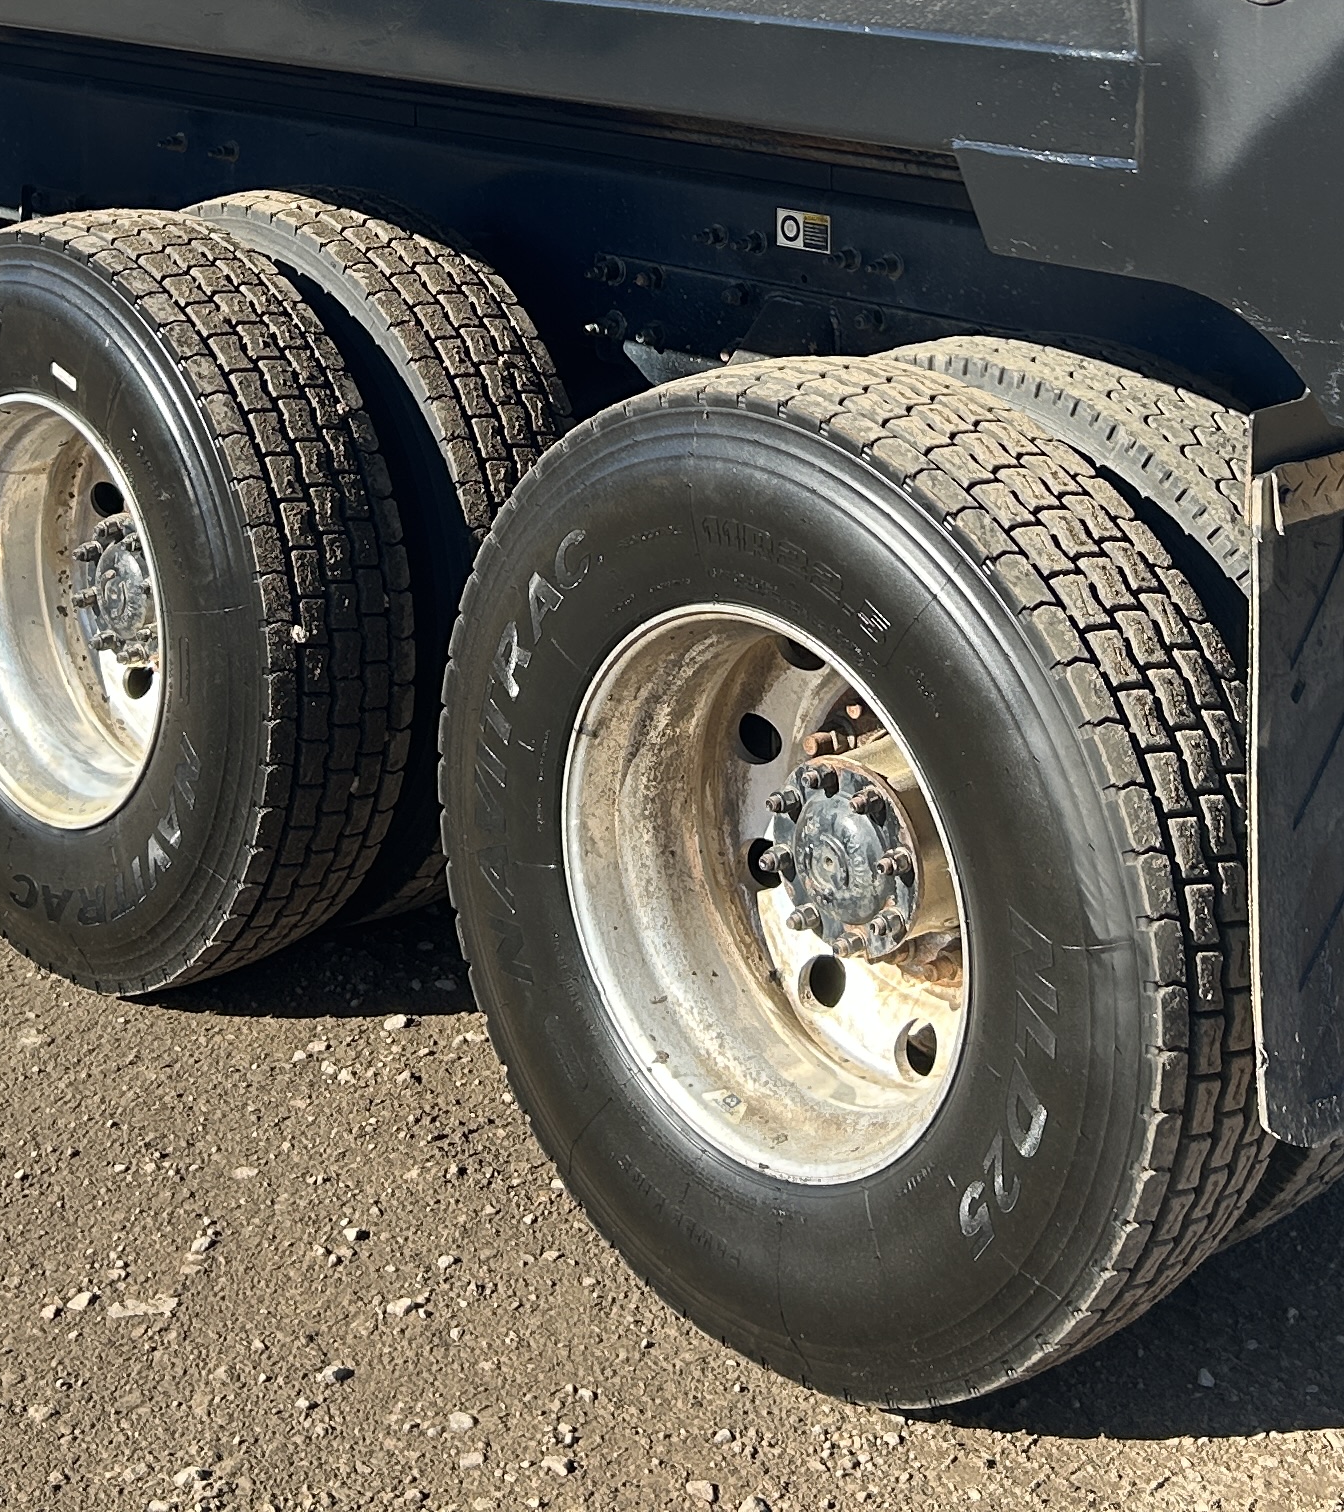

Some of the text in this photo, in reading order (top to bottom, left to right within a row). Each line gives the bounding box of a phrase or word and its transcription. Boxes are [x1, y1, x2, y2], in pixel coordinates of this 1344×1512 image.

[9, 731, 202, 927] NAVITRAC
[474, 528, 591, 986] NAVITRAC
[959, 903, 1058, 1262] NLD25
